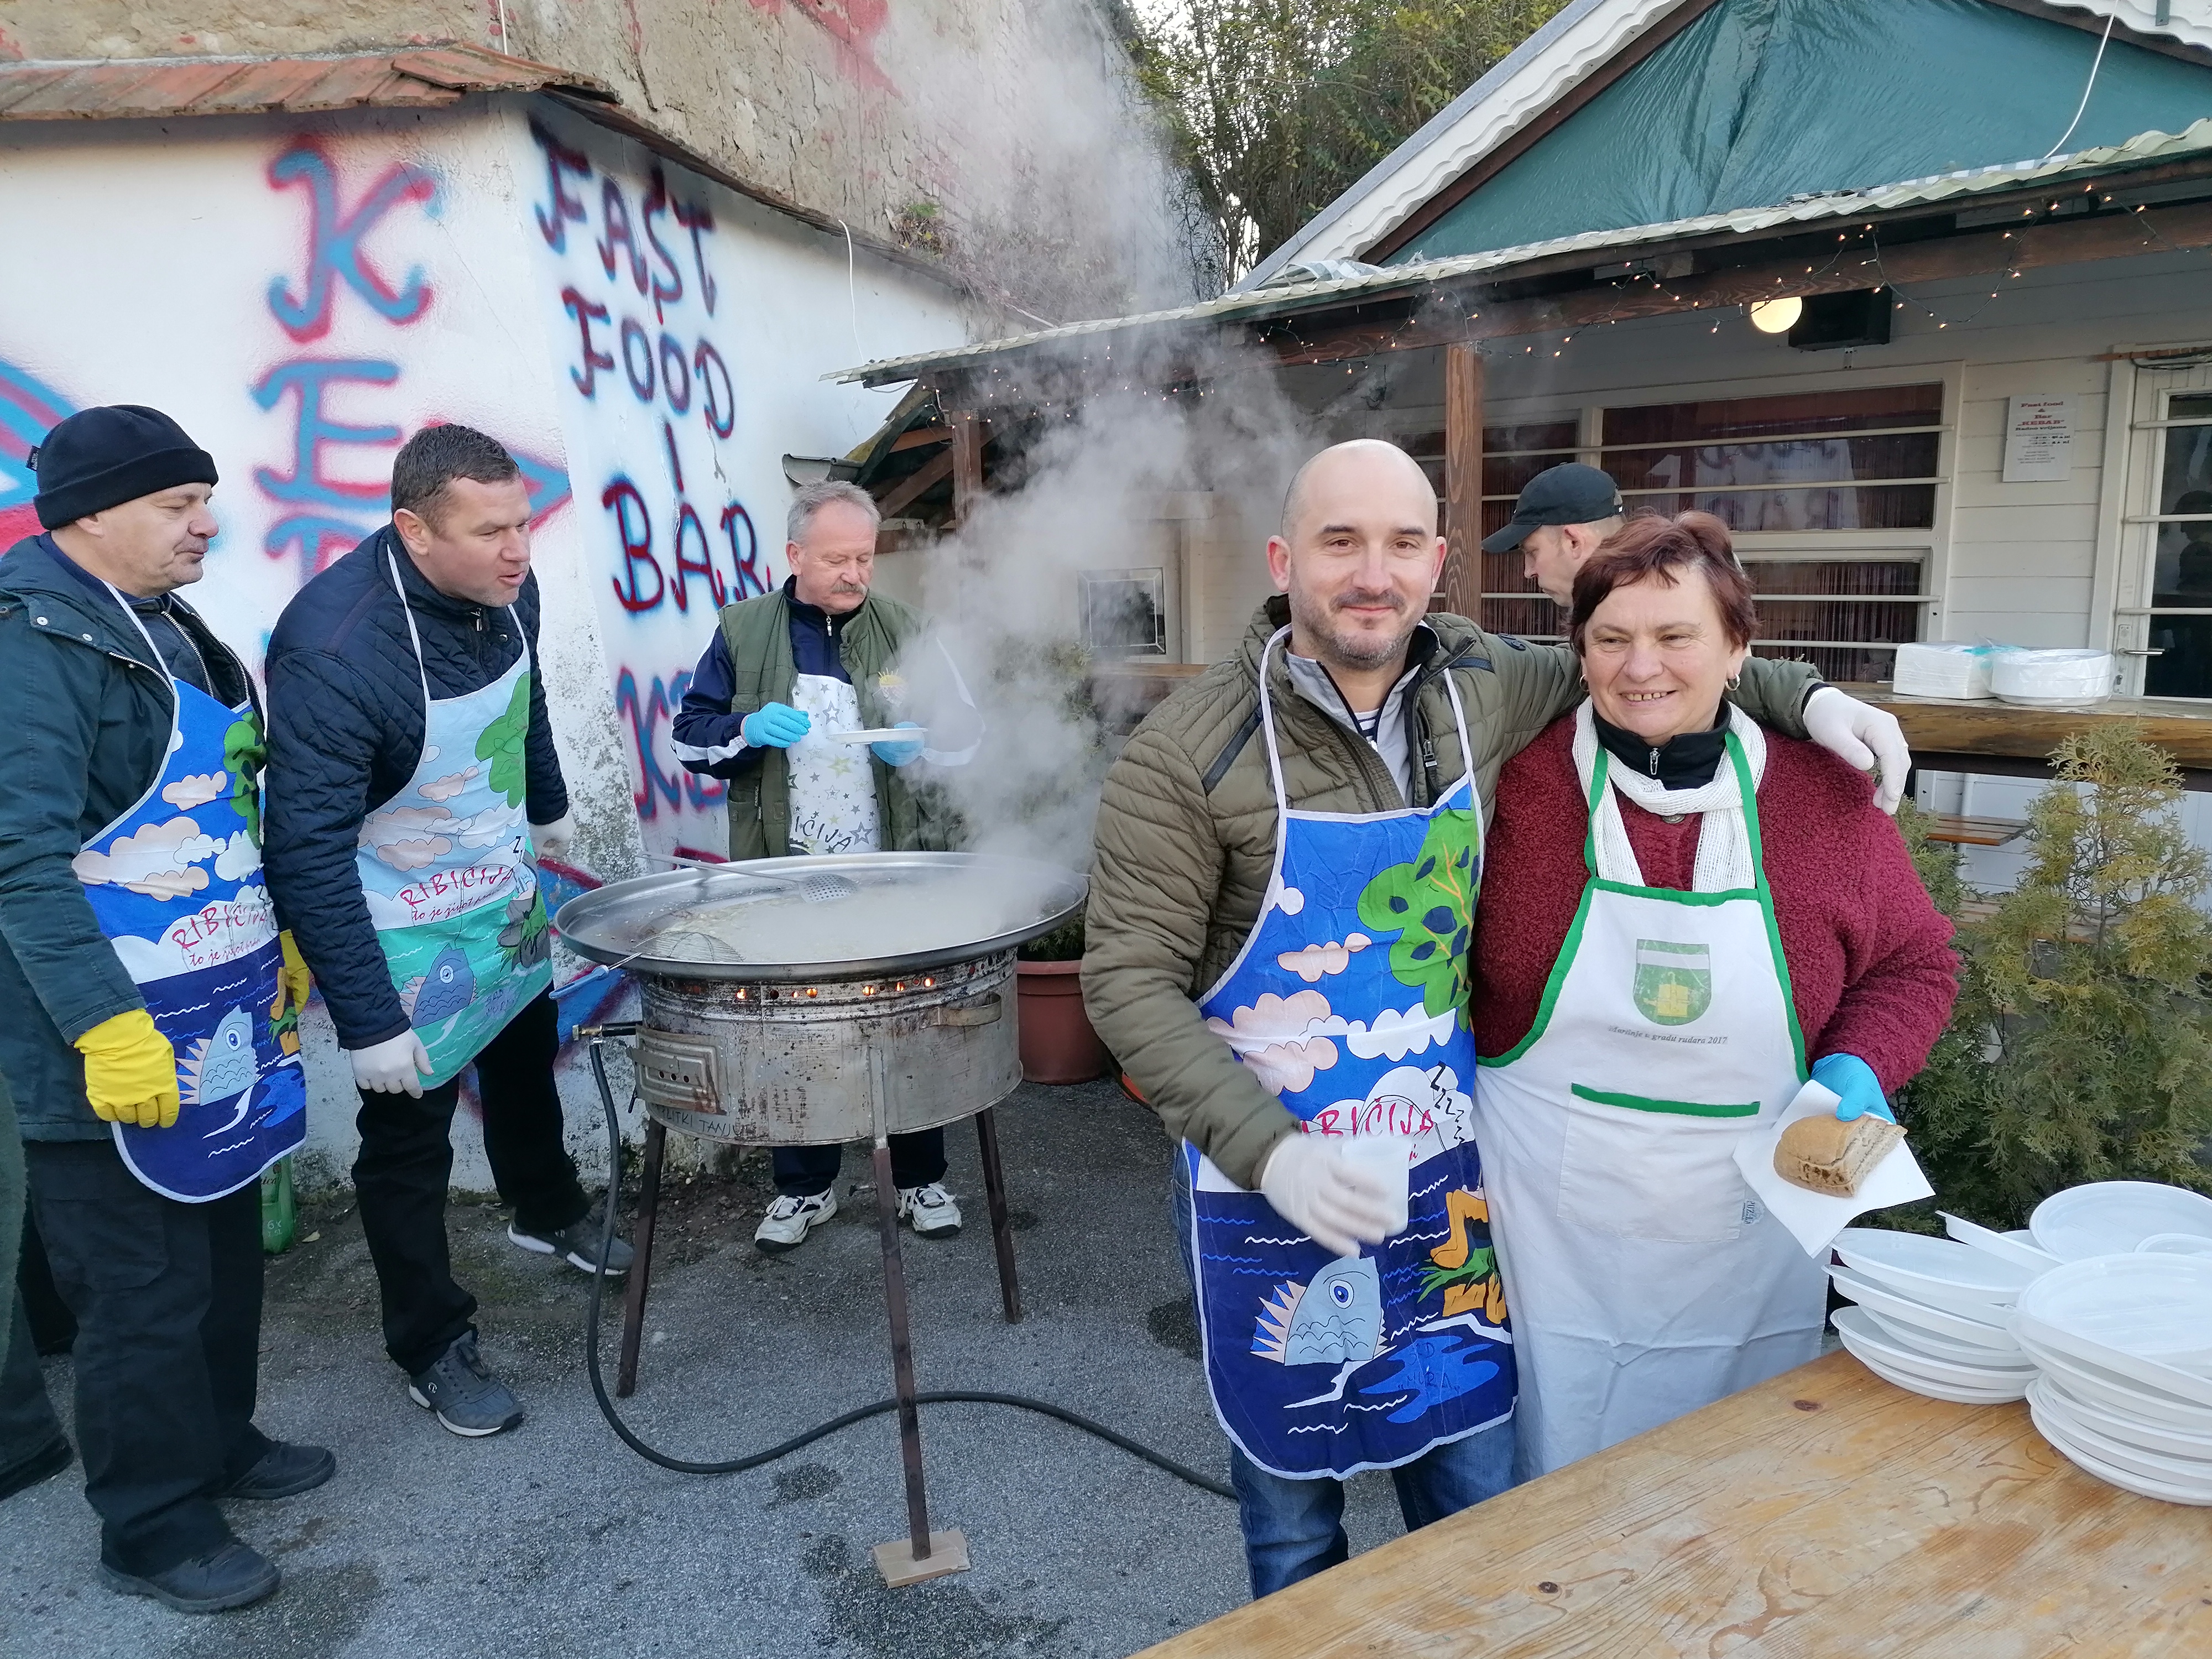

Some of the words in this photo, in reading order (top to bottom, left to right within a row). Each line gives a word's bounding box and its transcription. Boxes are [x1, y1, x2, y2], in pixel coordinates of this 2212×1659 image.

[529, 113, 719, 320] FAST
[561, 286, 734, 440] FOOD
[601, 477, 773, 614] BAR
[795, 812, 852, 853] IČIJA
[412, 910, 425, 921] to
[429, 906, 442, 921] je
[189, 953, 204, 967] to
[208, 950, 221, 967] je
[1678, 1036, 1706, 1044] rudara
[1707, 1036, 1728, 1045] 2017
